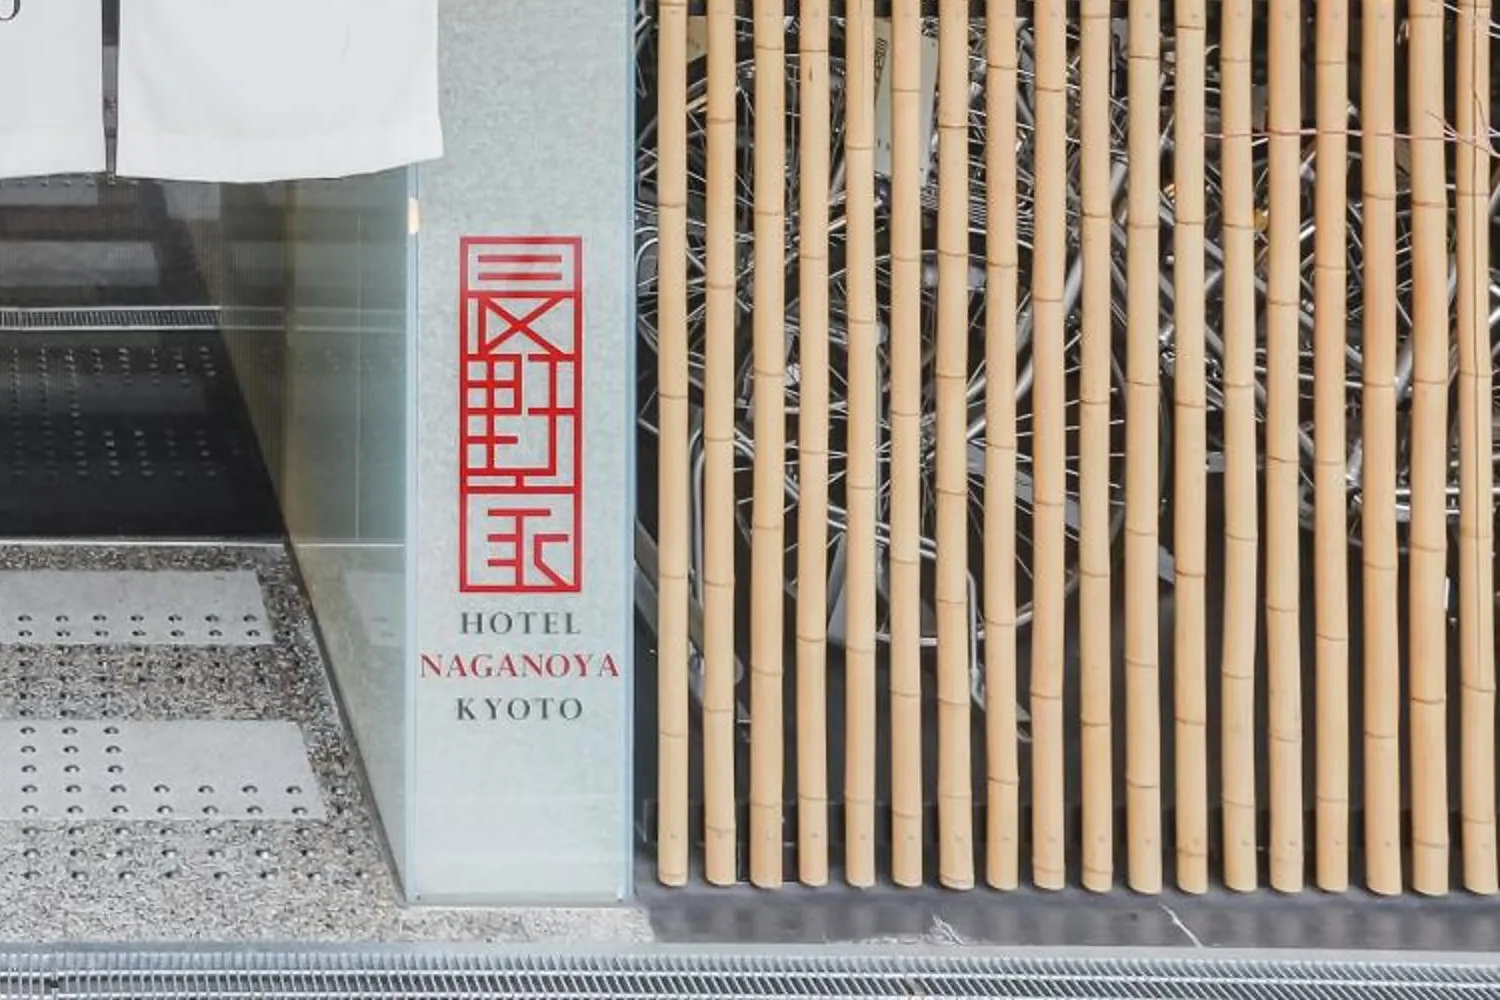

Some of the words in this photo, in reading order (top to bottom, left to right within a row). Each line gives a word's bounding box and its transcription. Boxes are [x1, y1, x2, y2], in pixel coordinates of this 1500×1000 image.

[461, 611, 581, 635] HOTEL
[420, 653, 620, 679] NAGANOYA
[456, 697, 583, 722] KYOTO
